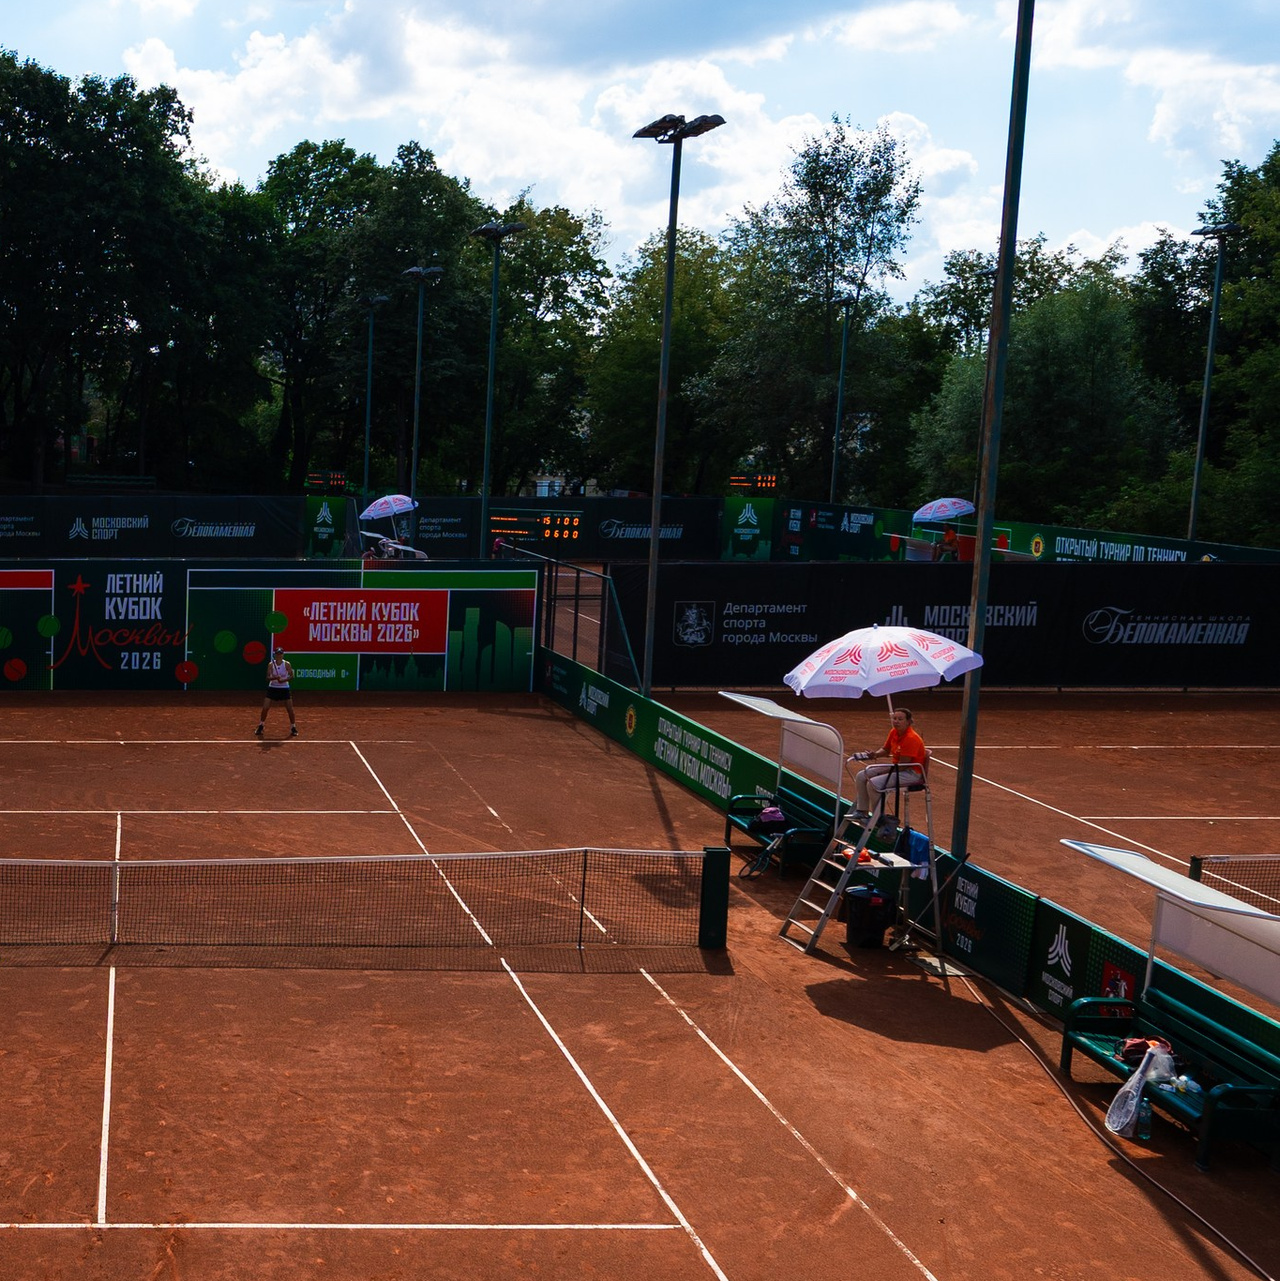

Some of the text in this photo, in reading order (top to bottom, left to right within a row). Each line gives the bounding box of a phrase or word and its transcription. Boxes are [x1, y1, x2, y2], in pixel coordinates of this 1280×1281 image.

[92, 515, 149, 529] МОСКОВСКИЙ
[92, 528, 119, 540] СПОРТ
[1055, 536, 1097, 558] ОТКРЫТЫЙ
[1100, 541, 1131, 560] ТУРНИР
[105, 571, 163, 594] ЛЕТНИЙ
[105, 597, 163, 620] КУБОК
[303, 600, 420, 622] «ЛЕТНИЙ КУБОК
[723, 602, 808, 616] Департамент
[924, 601, 1038, 626] МОСКВСКИЙ
[308, 623, 420, 643] МОСКВЫ 2026»
[723, 619, 766, 631] спорта
[1082, 606, 1251, 645] БЕЛОКАМЕННАЯ
[722, 631, 818, 646] города Москвы
[120, 651, 162, 670] 2026
[876, 659, 918, 673] МОСКОВСКИЙ
[296, 668, 336, 679] СВОБОДНЫЙ
[889, 669, 910, 677] СПОРТ
[956, 876, 979, 900] ЛЕТНИЙ
[954, 891, 977, 919] КУБОК
[956, 932, 972, 954] 2026
[1042, 971, 1073, 999] МОСКОВСКИЙ
[1048, 989, 1063, 1007] СПОРТ
